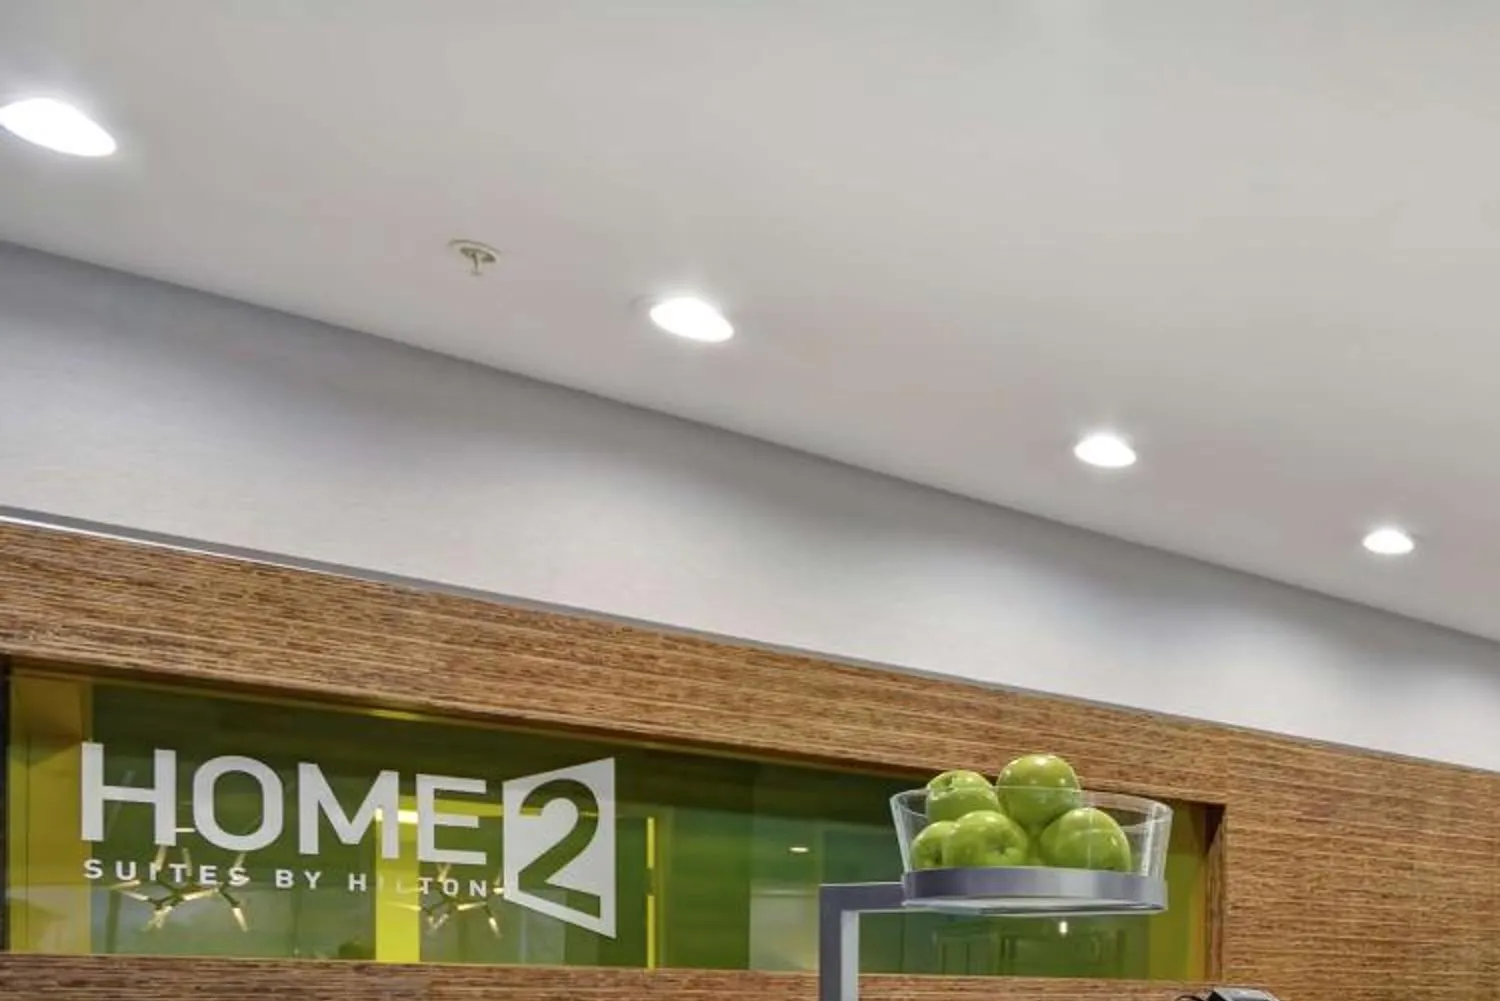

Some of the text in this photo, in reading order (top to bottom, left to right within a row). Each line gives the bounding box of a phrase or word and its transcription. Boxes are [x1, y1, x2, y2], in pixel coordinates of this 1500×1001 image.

[82, 858, 488, 897] SUITES BY HILTON
